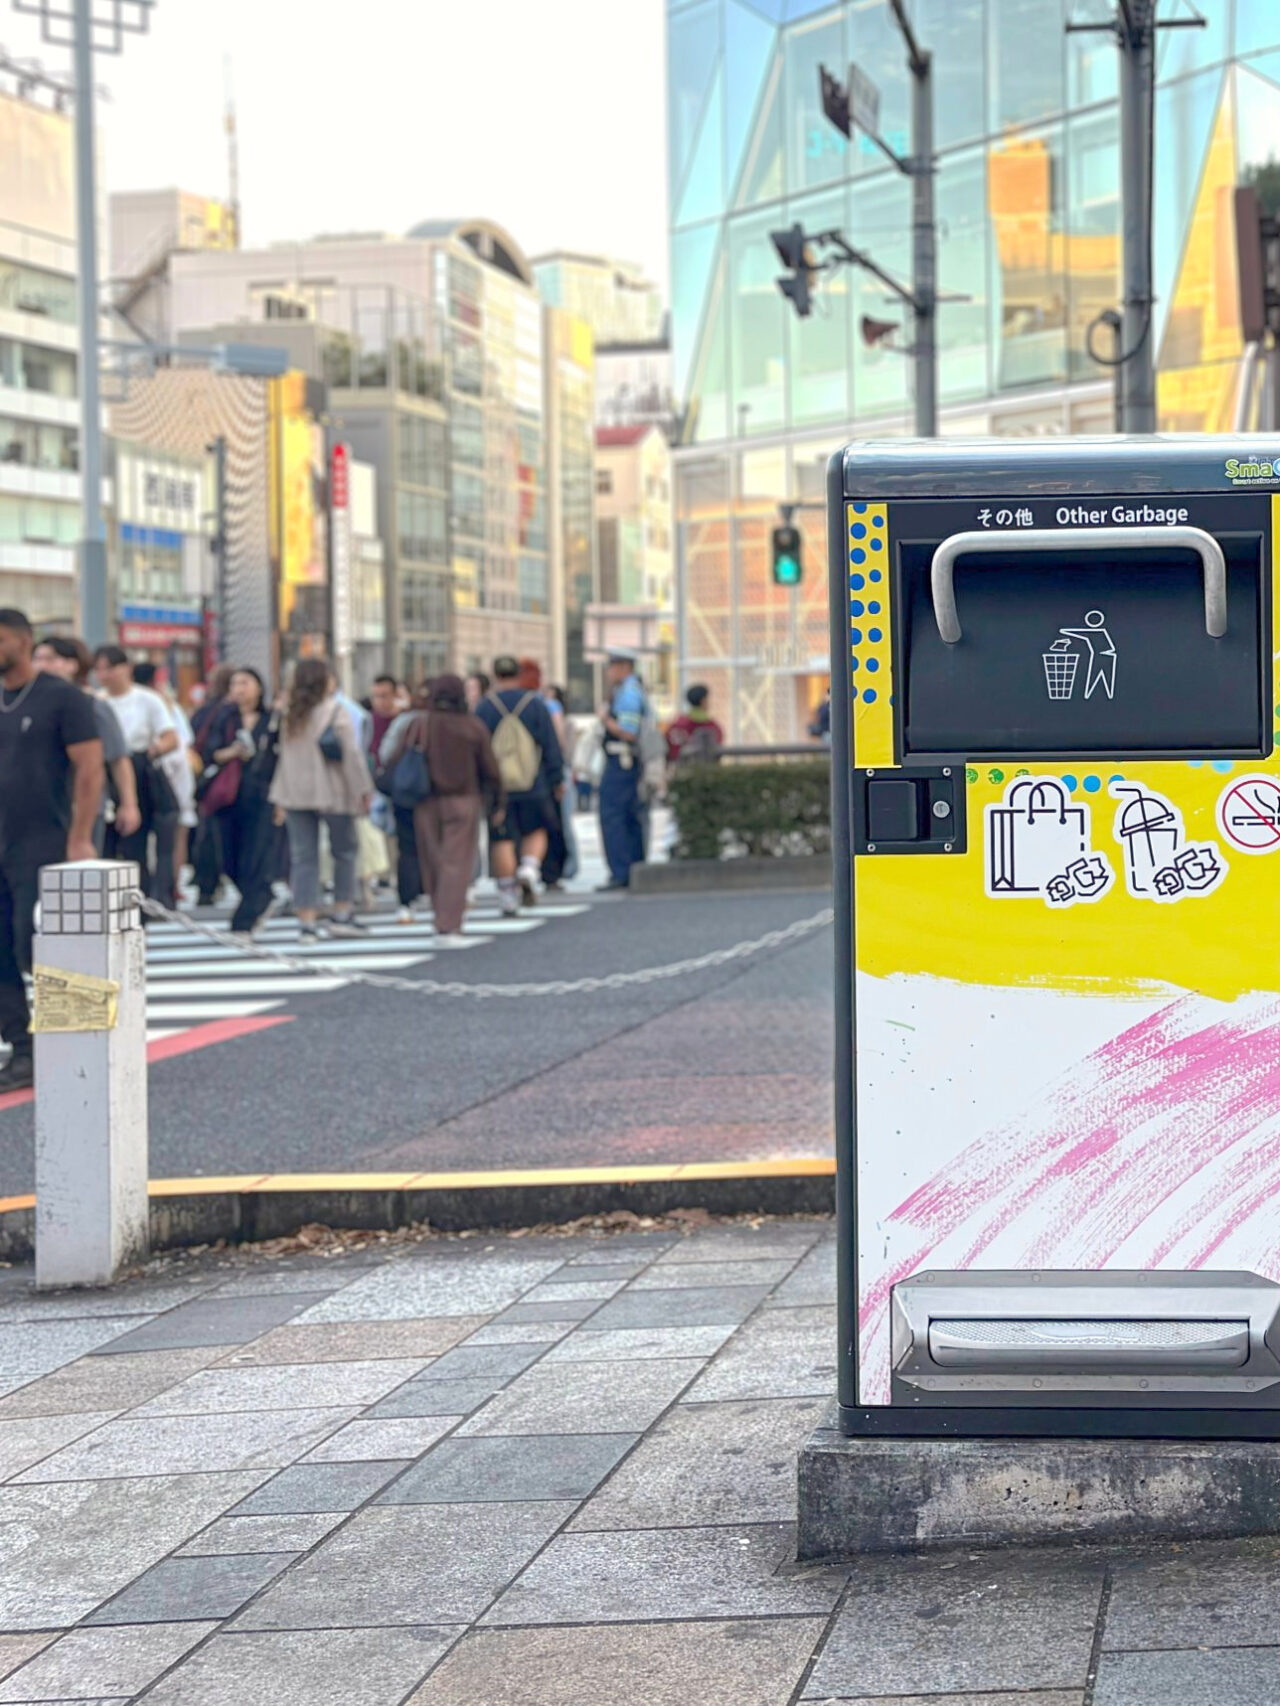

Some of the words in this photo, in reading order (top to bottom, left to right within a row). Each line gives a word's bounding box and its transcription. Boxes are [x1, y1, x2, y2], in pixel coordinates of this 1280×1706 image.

[977, 509, 1034, 527] その他
[1056, 507, 1107, 524] Other
[1111, 505, 1189, 526] Garbage
